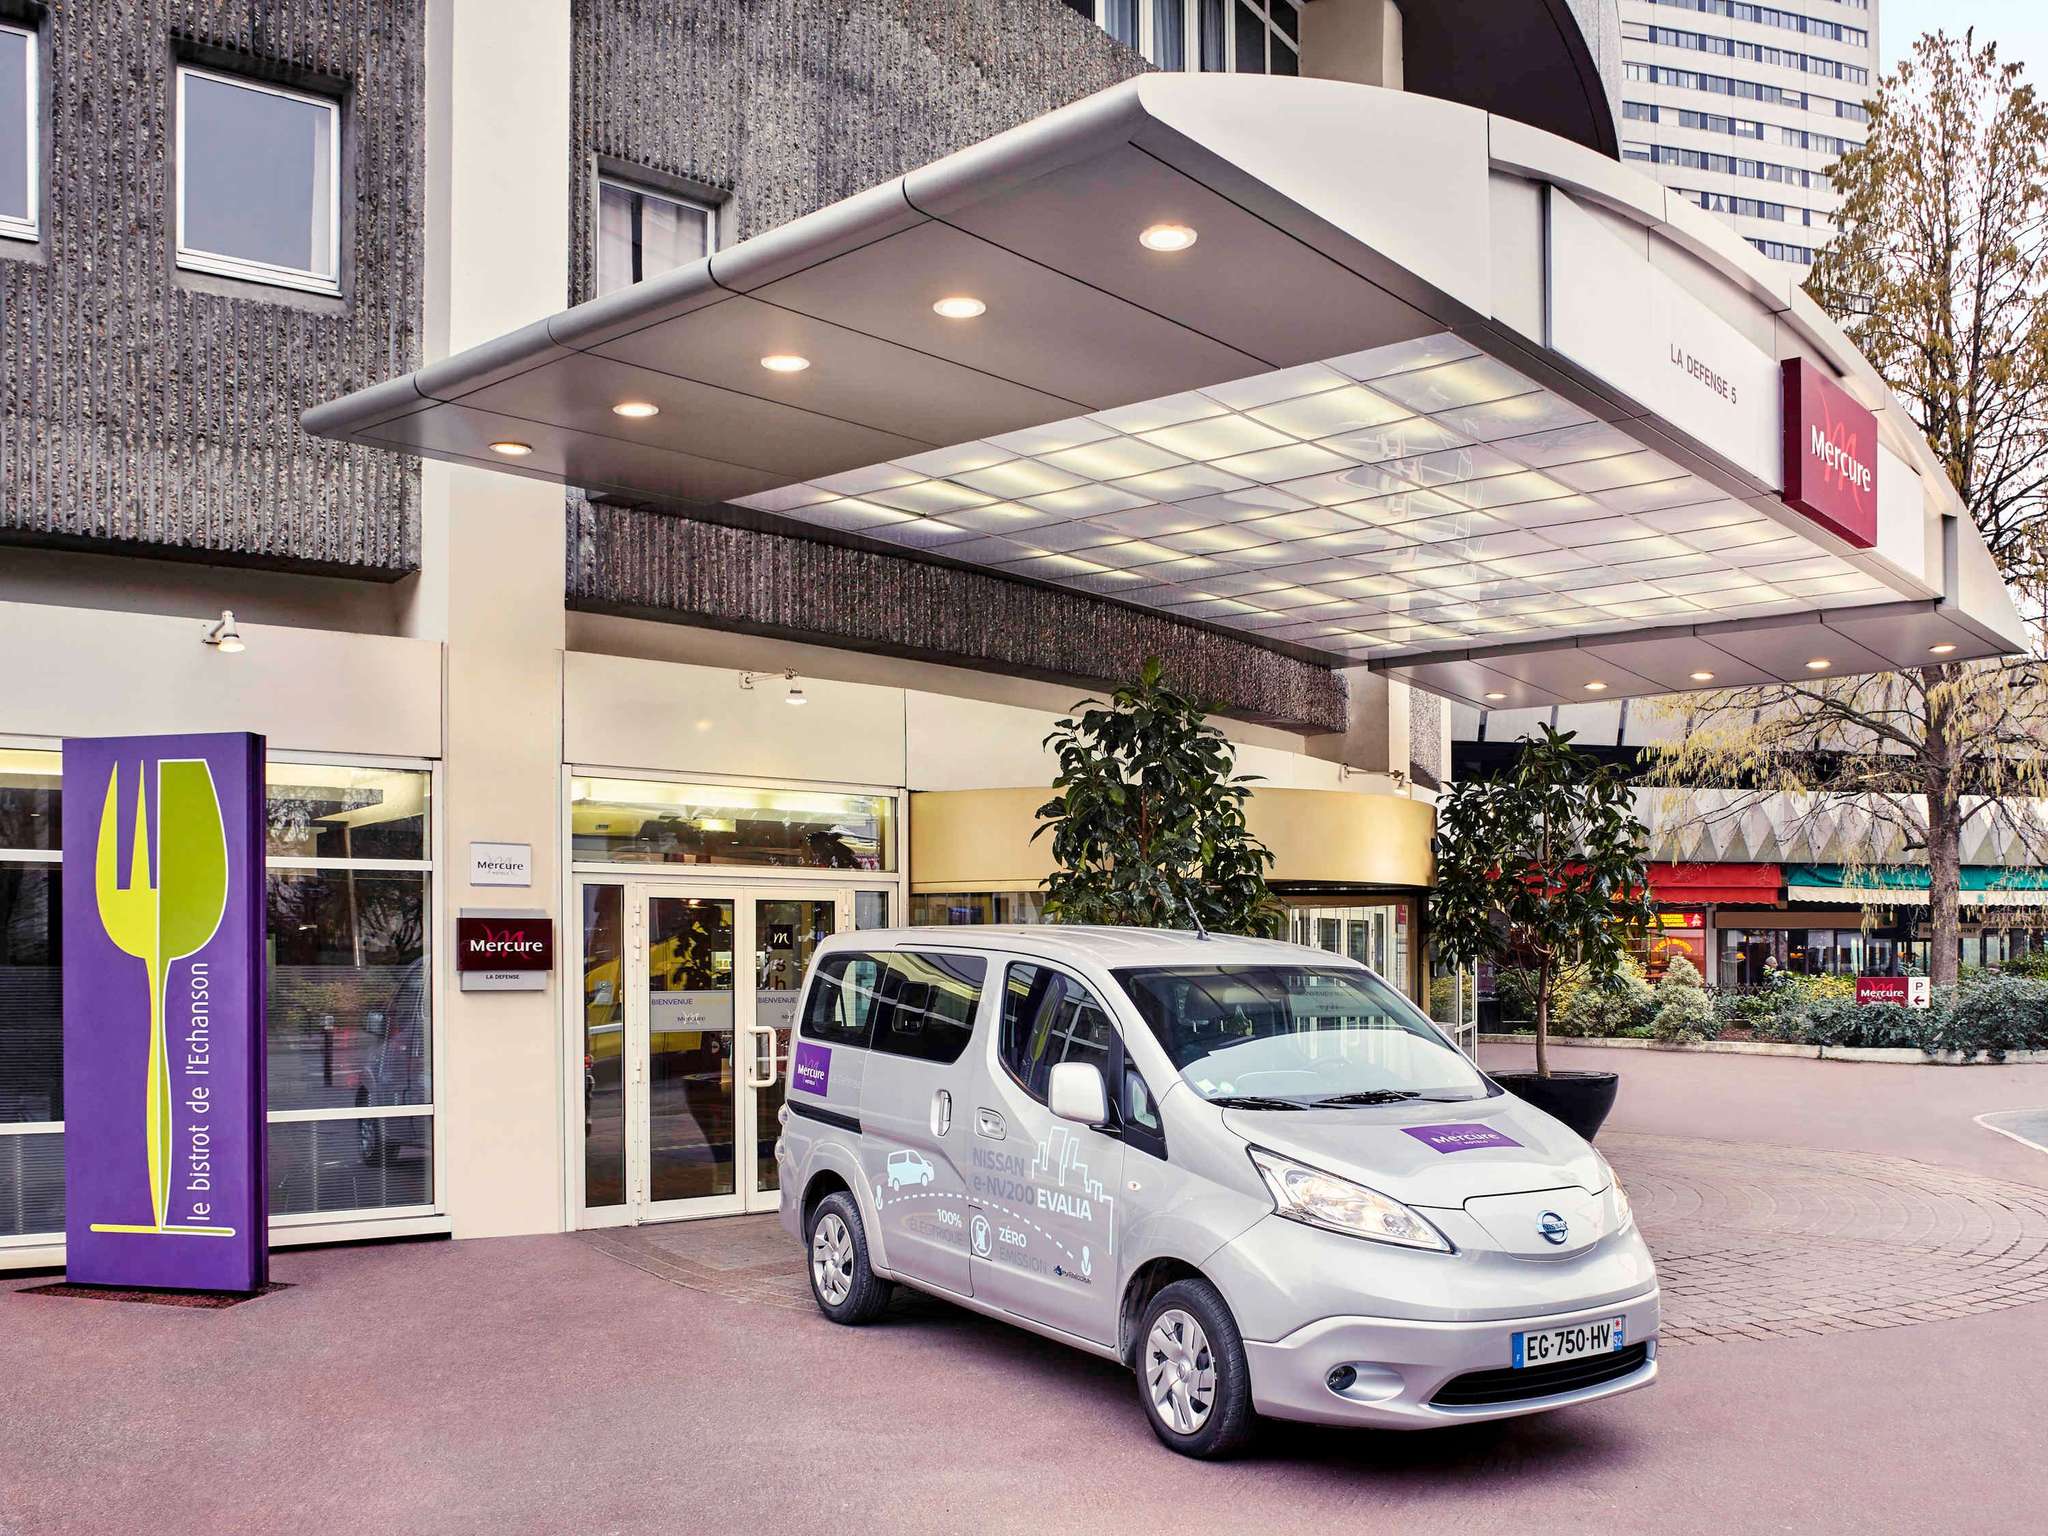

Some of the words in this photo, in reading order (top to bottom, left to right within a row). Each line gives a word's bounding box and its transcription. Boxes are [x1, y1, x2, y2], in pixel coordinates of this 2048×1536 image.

[1671, 344, 1684, 368] LA
[1687, 355, 1728, 399] DEFENSE
[1731, 387, 1737, 404] 5
[1811, 424, 1871, 492] Mercure
[477, 860, 524, 871] Mercure
[470, 939, 543, 952] Mercure
[1860, 989, 1905, 998] Mercure
[1915, 982, 1924, 991] P
[651, 998, 694, 1006] BIENVENUE
[185, 963, 209, 1074] l'Echanson
[797, 1063, 825, 1080] Mercure
[185, 1087, 210, 1113] de
[1431, 1131, 1501, 1144] Mercure
[186, 1124, 210, 1190] bistrot
[973, 1148, 1025, 1177] NISSAN
[974, 1175, 1035, 1206] e-NV200
[1037, 1188, 1092, 1221] EVALIA
[186, 1202, 211, 1221] le
[936, 1208, 963, 1228] 100%
[999, 1225, 1027, 1248] ZÉRO
[1613, 1335, 1623, 1347] 92
